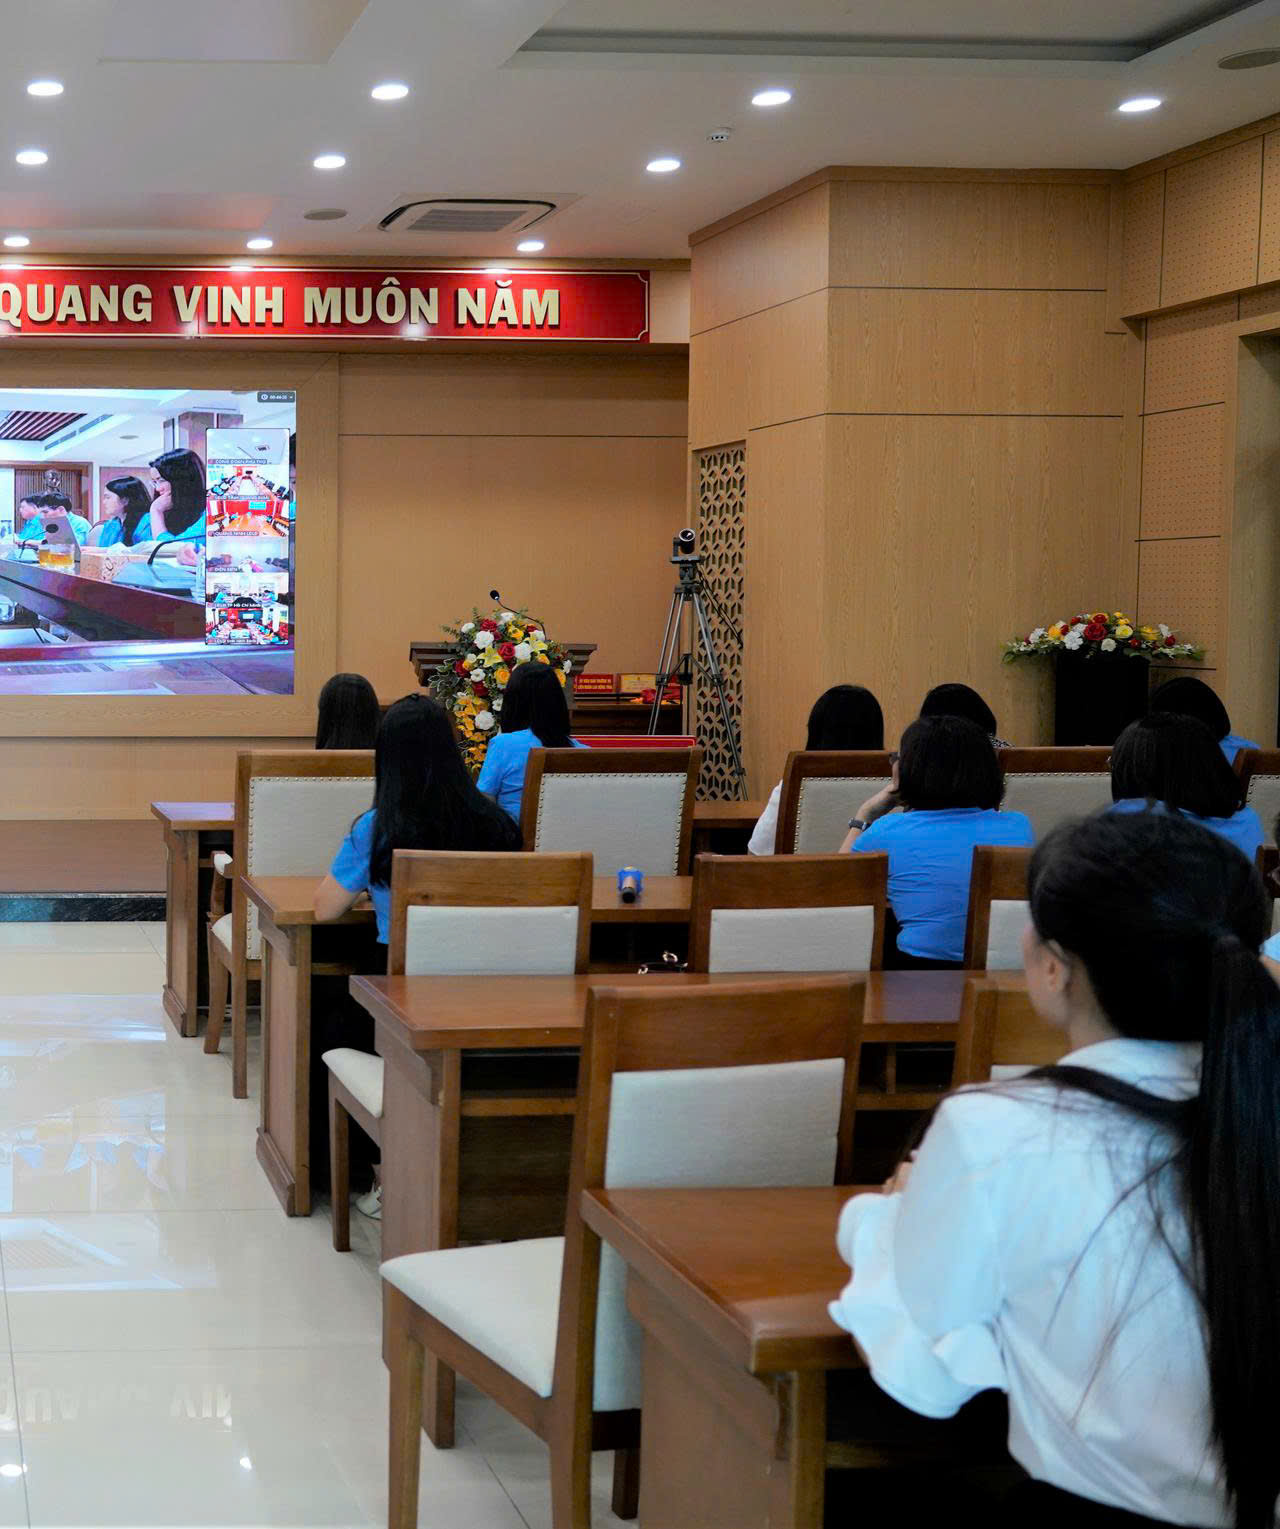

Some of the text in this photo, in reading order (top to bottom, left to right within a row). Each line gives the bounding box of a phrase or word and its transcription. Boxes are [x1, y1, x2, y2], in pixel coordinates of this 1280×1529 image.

[172, 285, 284, 324] VINH
[303, 277, 440, 325] MUÔN
[457, 279, 560, 327] NĂM
